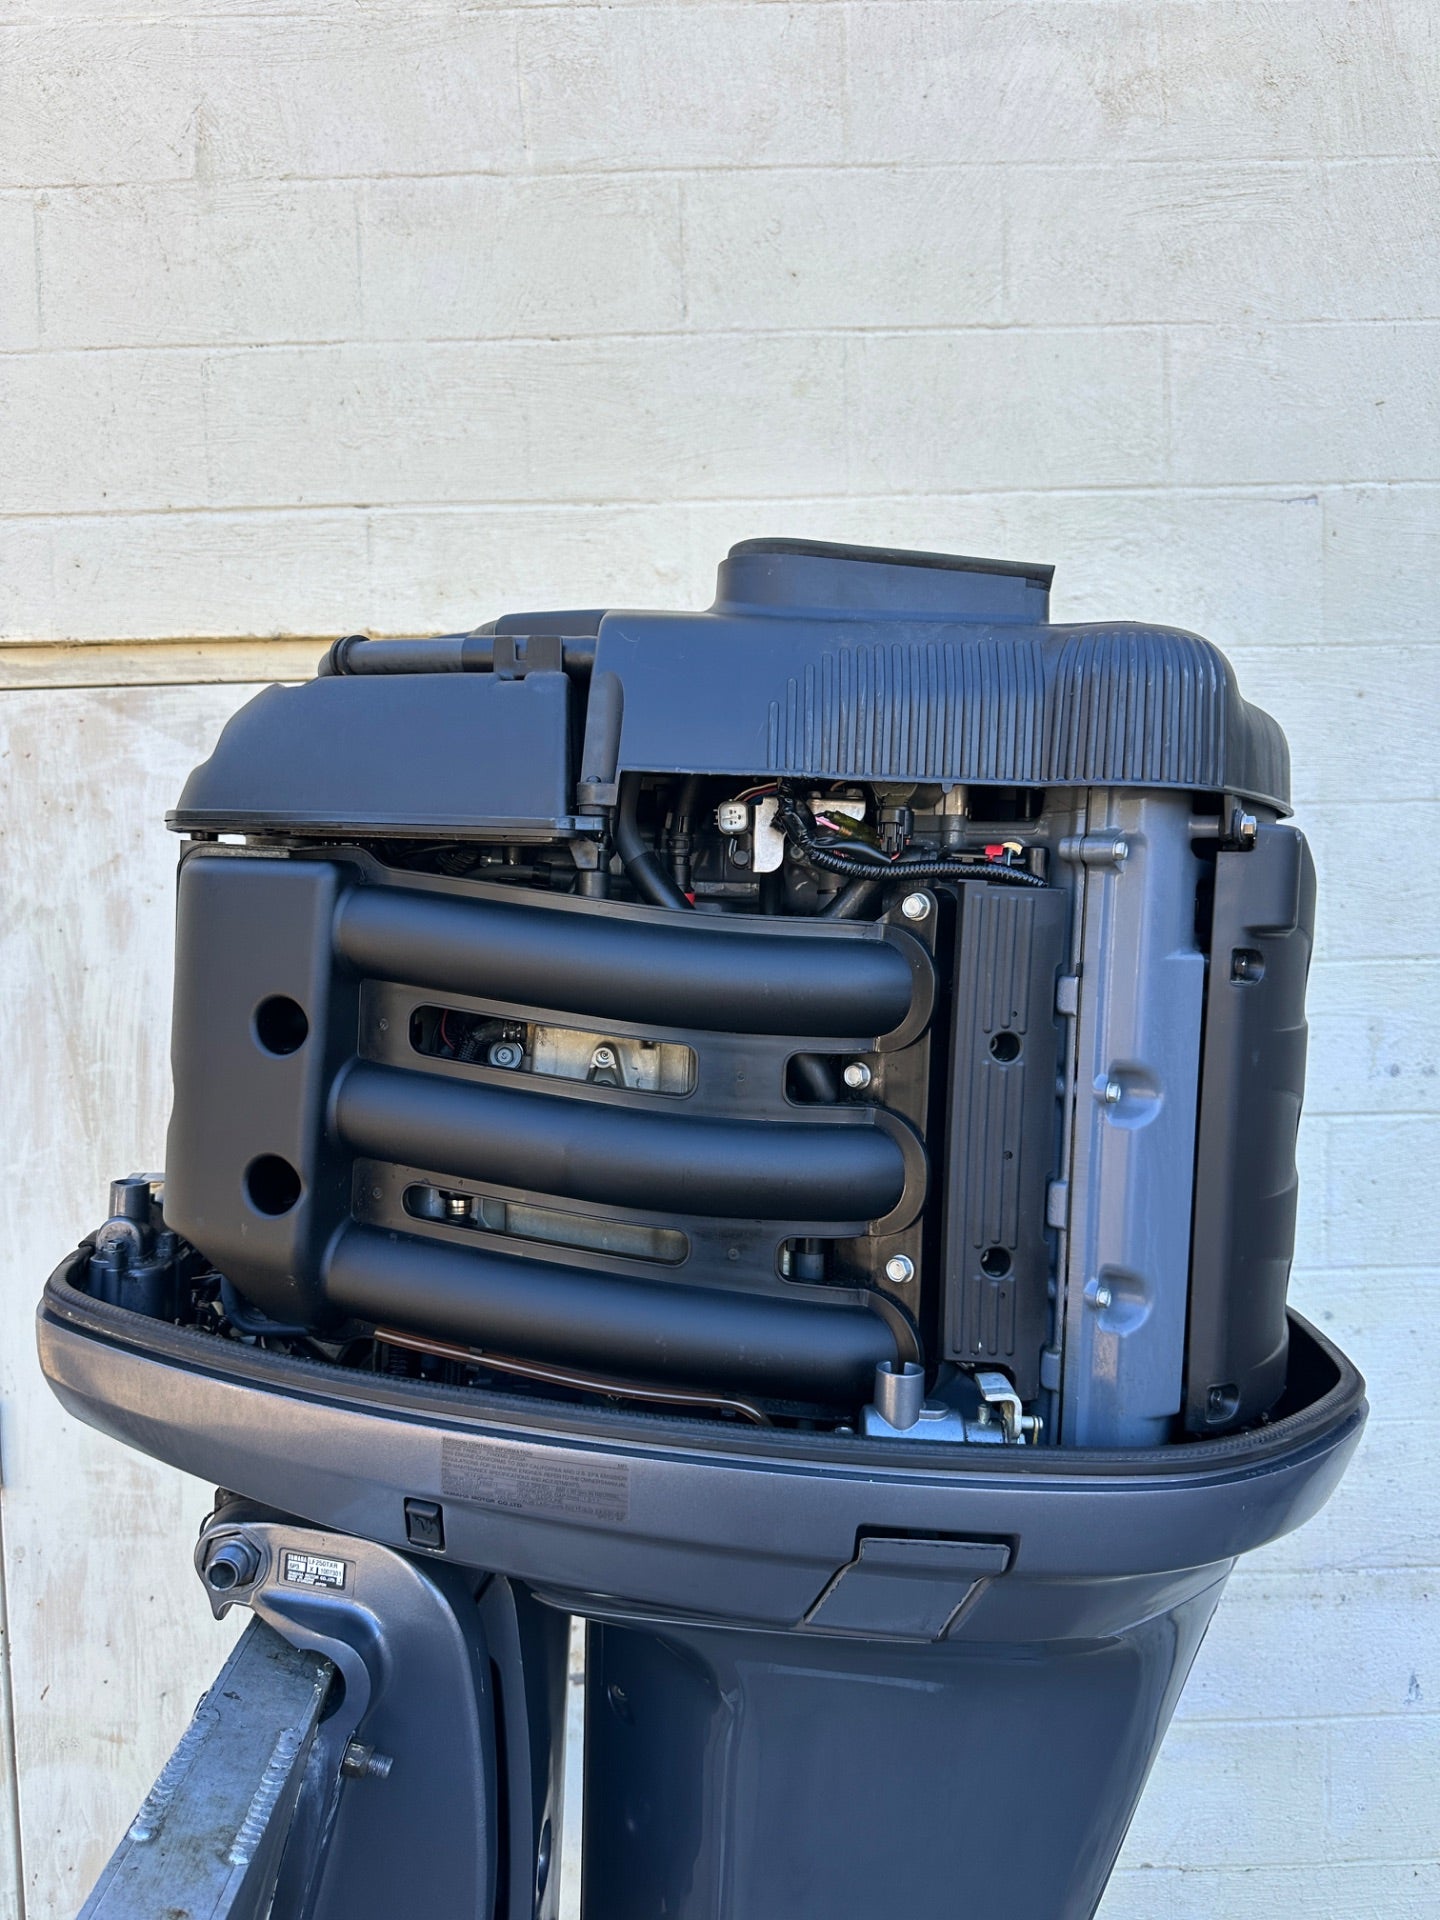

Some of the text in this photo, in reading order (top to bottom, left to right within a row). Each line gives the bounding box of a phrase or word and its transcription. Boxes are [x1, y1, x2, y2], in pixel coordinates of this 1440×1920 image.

[470, 1442, 494, 1450] CONTROL
[496, 1446, 533, 1456] INFORMATION
[472, 1495, 496, 1503] MOTOR
[308, 1559, 338, 1568] LF250TXR
